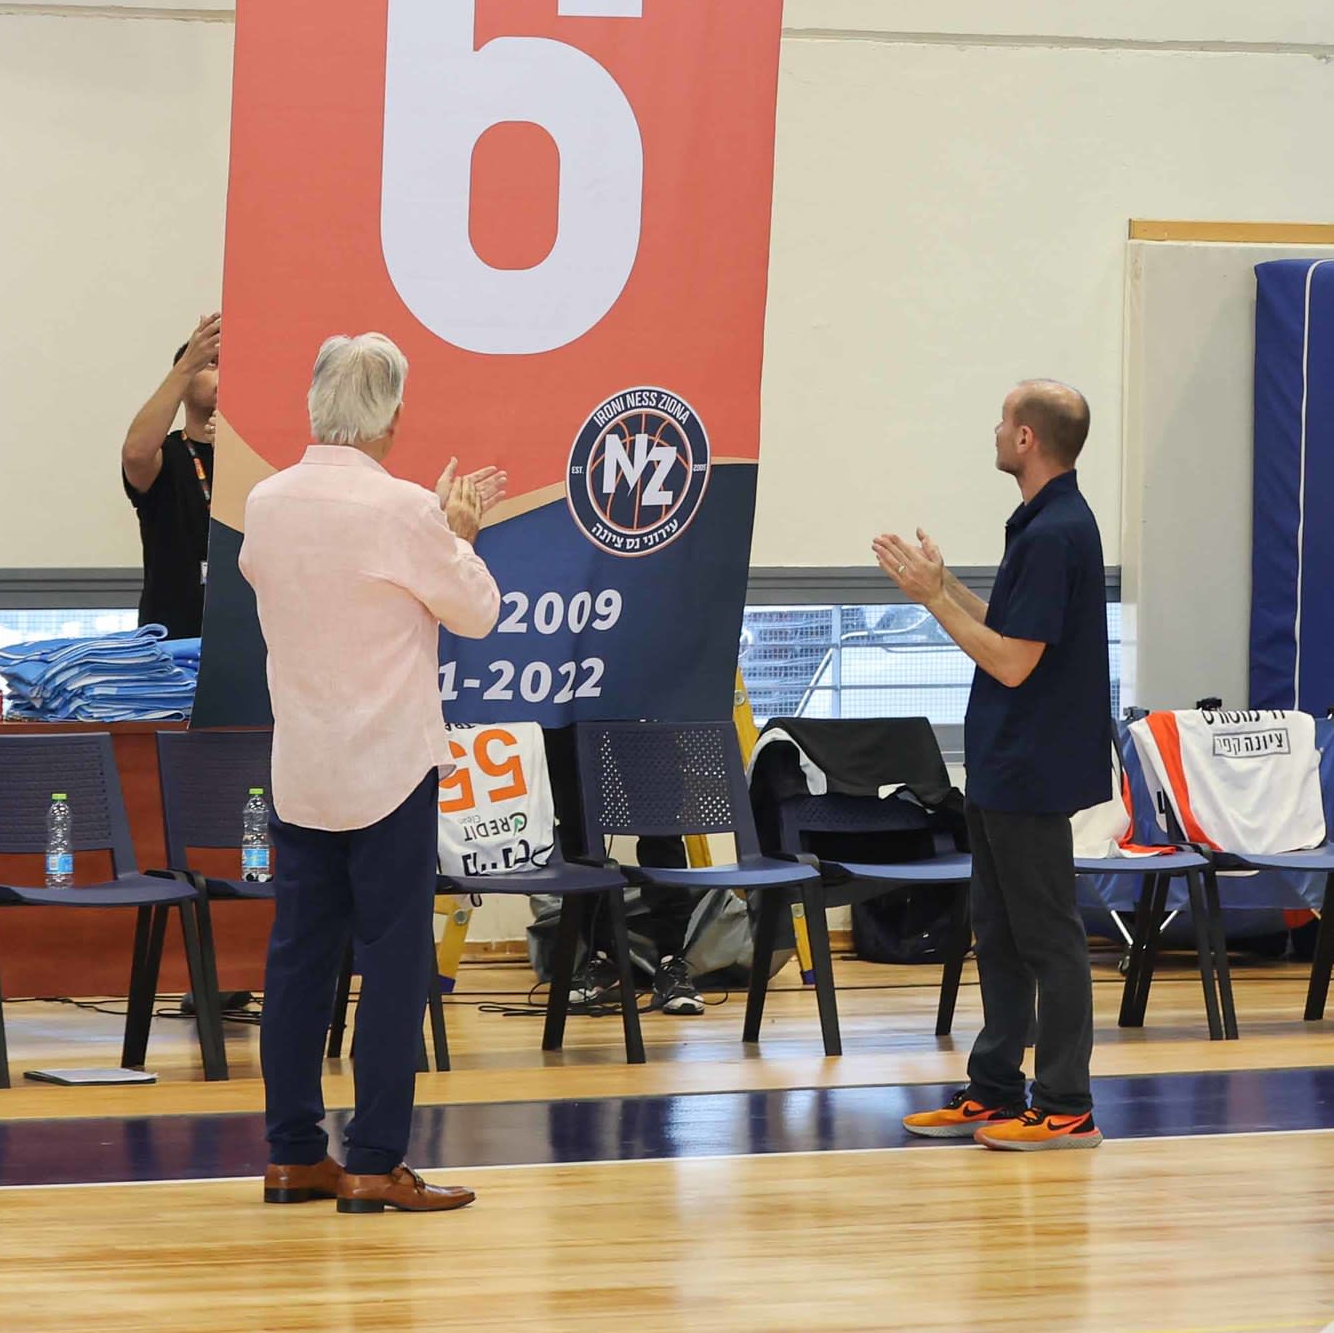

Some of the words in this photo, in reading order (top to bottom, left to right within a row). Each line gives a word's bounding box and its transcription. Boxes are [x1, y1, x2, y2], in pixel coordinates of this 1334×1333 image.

[592, 400, 625, 428] IRONI
[626, 391, 658, 409] NESS
[658, 394, 690, 425] ZIONA
[602, 433, 677, 506] NZ
[591, 521, 624, 549] ציונה
[626, 537, 640, 550] נס
[642, 518, 679, 546] עירוני
[497, 589, 623, 635] 2009
[1244, 732, 1283, 752] ציונה
[464, 812, 528, 842] CREDIT
